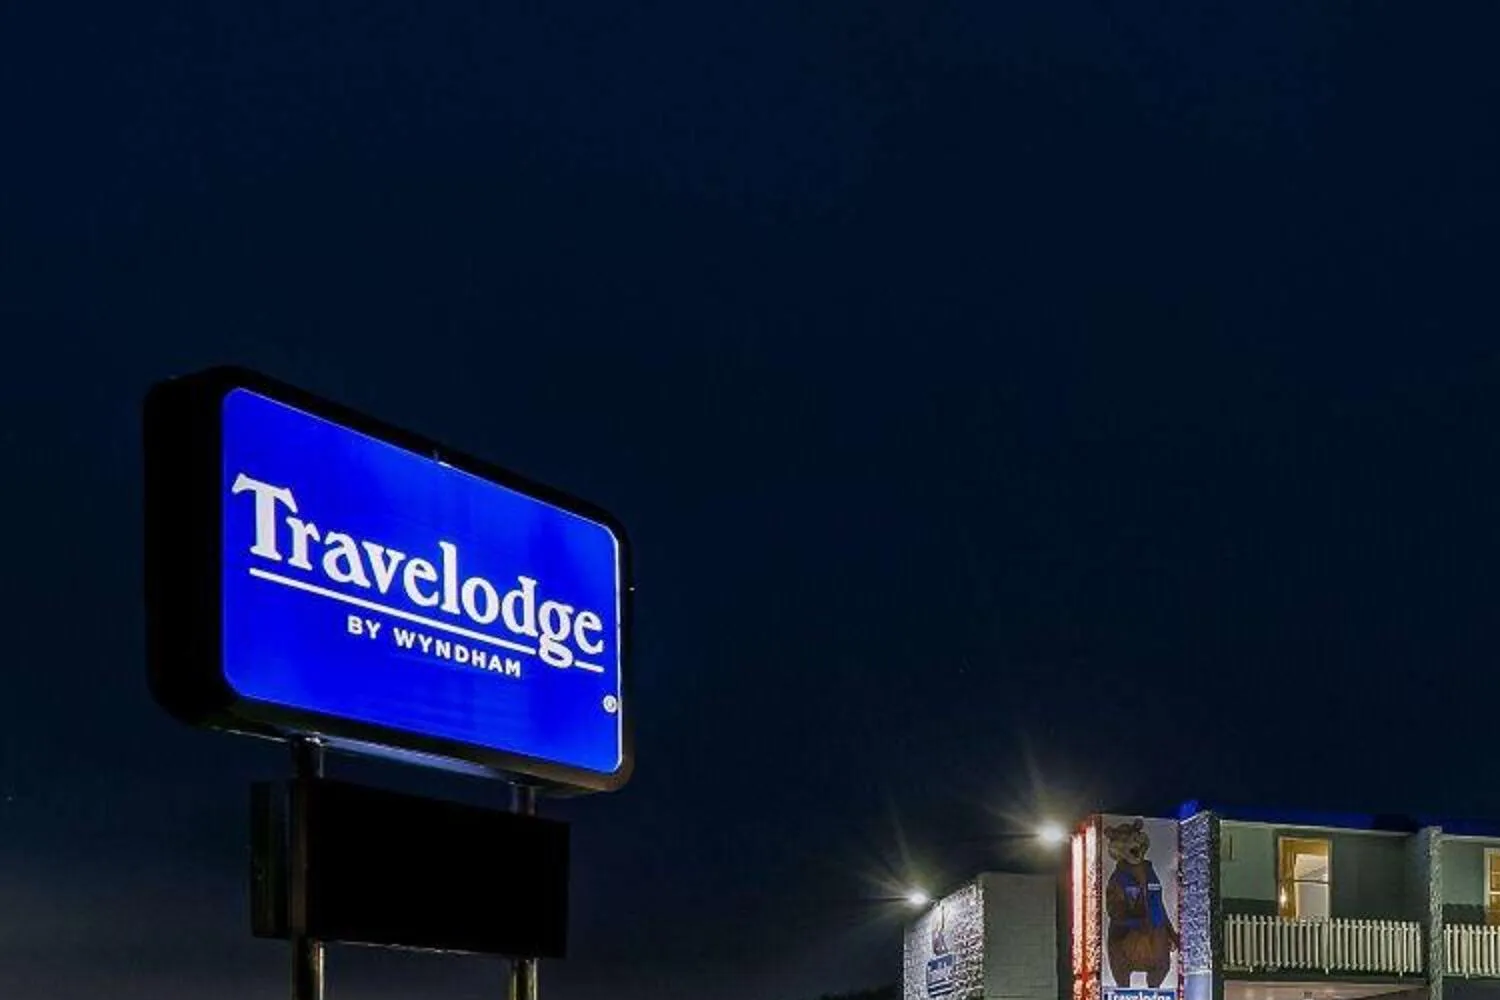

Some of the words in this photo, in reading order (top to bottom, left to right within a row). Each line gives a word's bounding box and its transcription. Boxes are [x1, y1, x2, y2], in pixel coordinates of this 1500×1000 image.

[231, 472, 604, 668] Travelodge
[346, 615, 382, 640] BY
[393, 627, 522, 678] WYNDHAM
